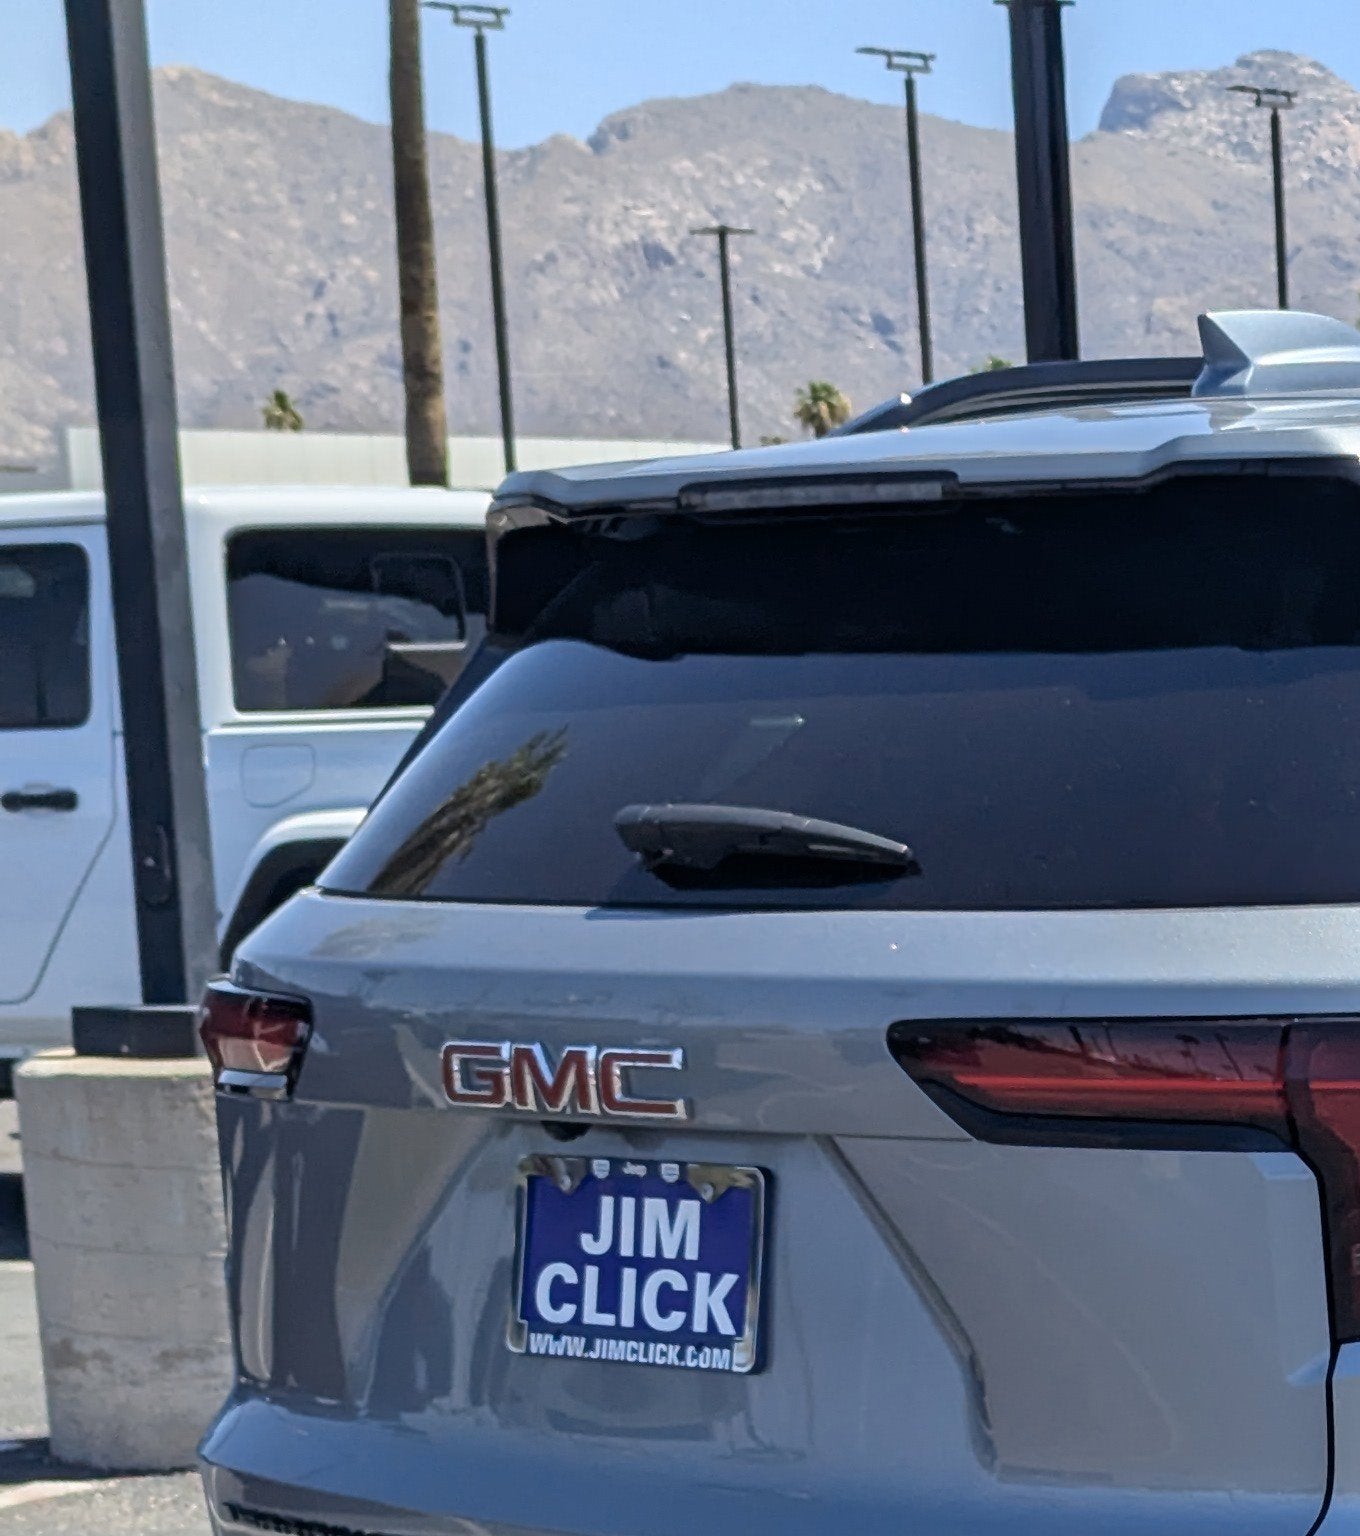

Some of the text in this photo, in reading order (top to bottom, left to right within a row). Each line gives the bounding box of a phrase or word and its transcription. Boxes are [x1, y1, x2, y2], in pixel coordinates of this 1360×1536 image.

[441, 1041, 688, 1119] GMC
[580, 1196, 701, 1261] JIM
[534, 1262, 740, 1336] CLICK
[529, 1332, 731, 1370] WWW.JIMCLICK.COM
